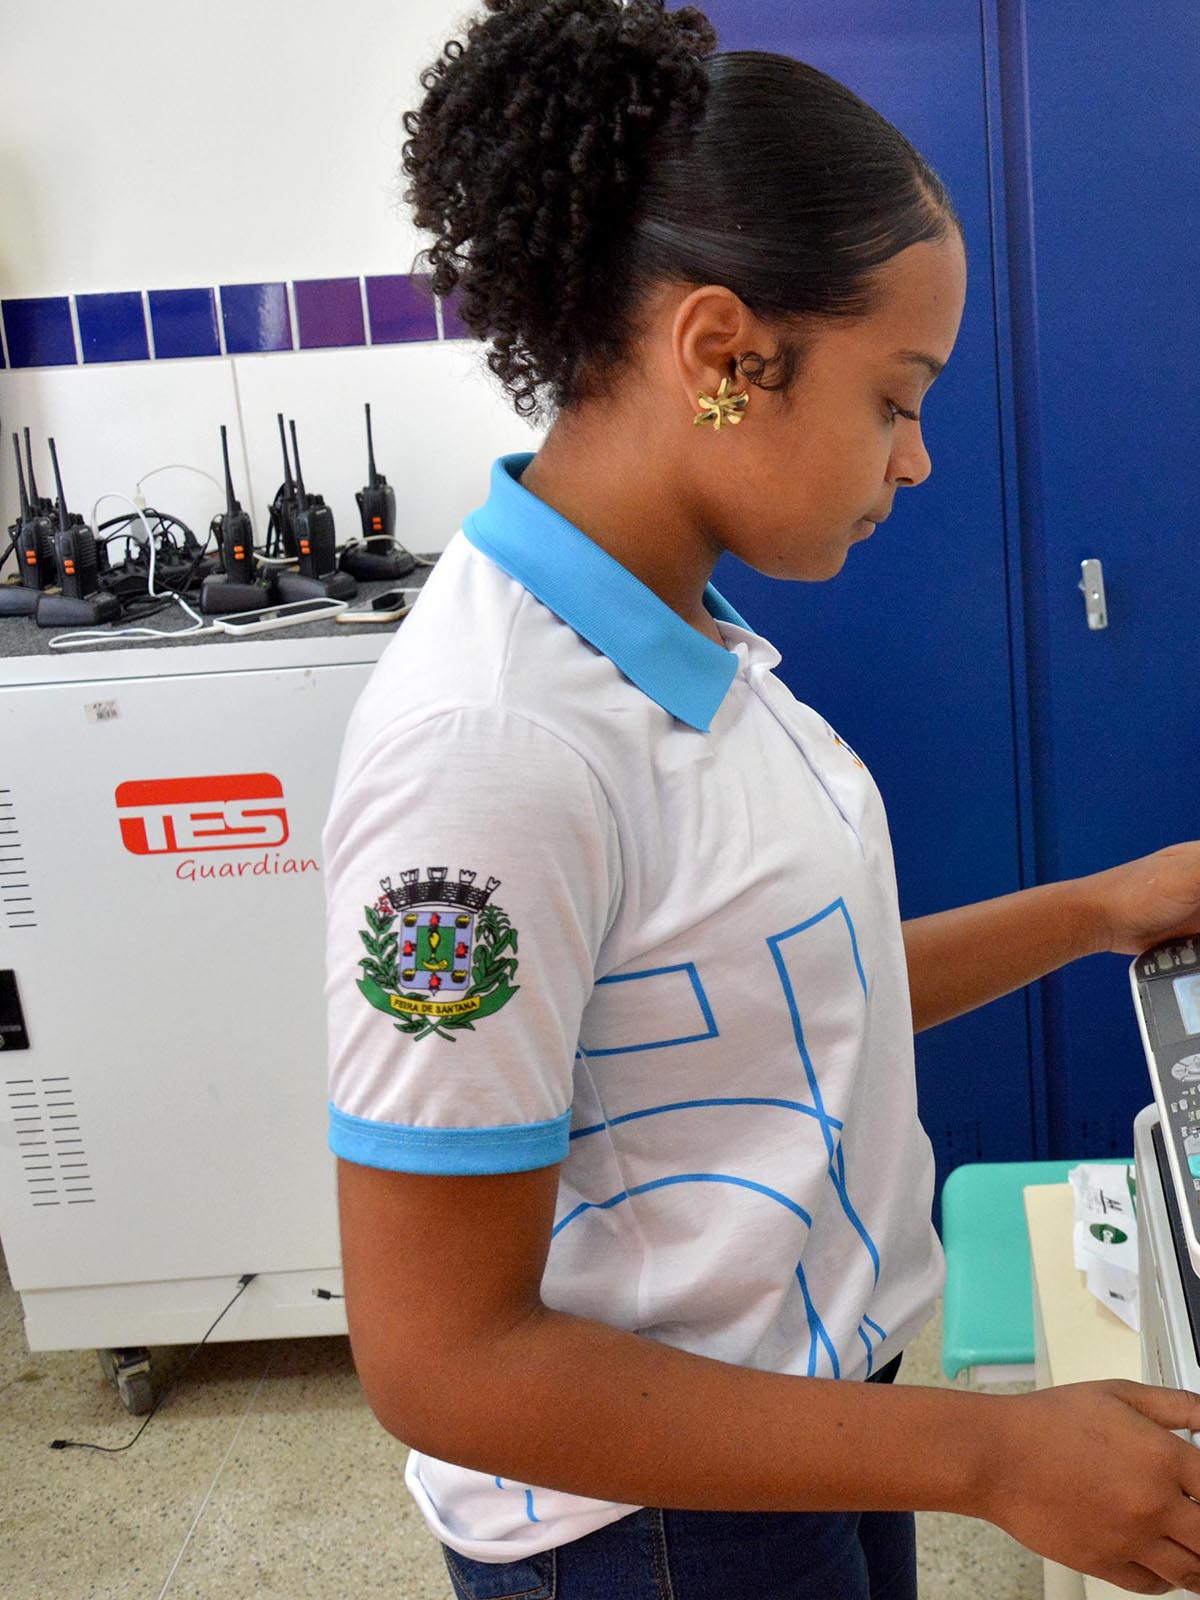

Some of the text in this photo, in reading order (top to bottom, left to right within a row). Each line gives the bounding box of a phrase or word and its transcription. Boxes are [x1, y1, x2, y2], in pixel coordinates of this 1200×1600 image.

[117, 796, 289, 852] TES
[176, 853, 320, 881] Guardian
[394, 999, 418, 1012] FEIRA
[421, 1003, 433, 1013] DE
